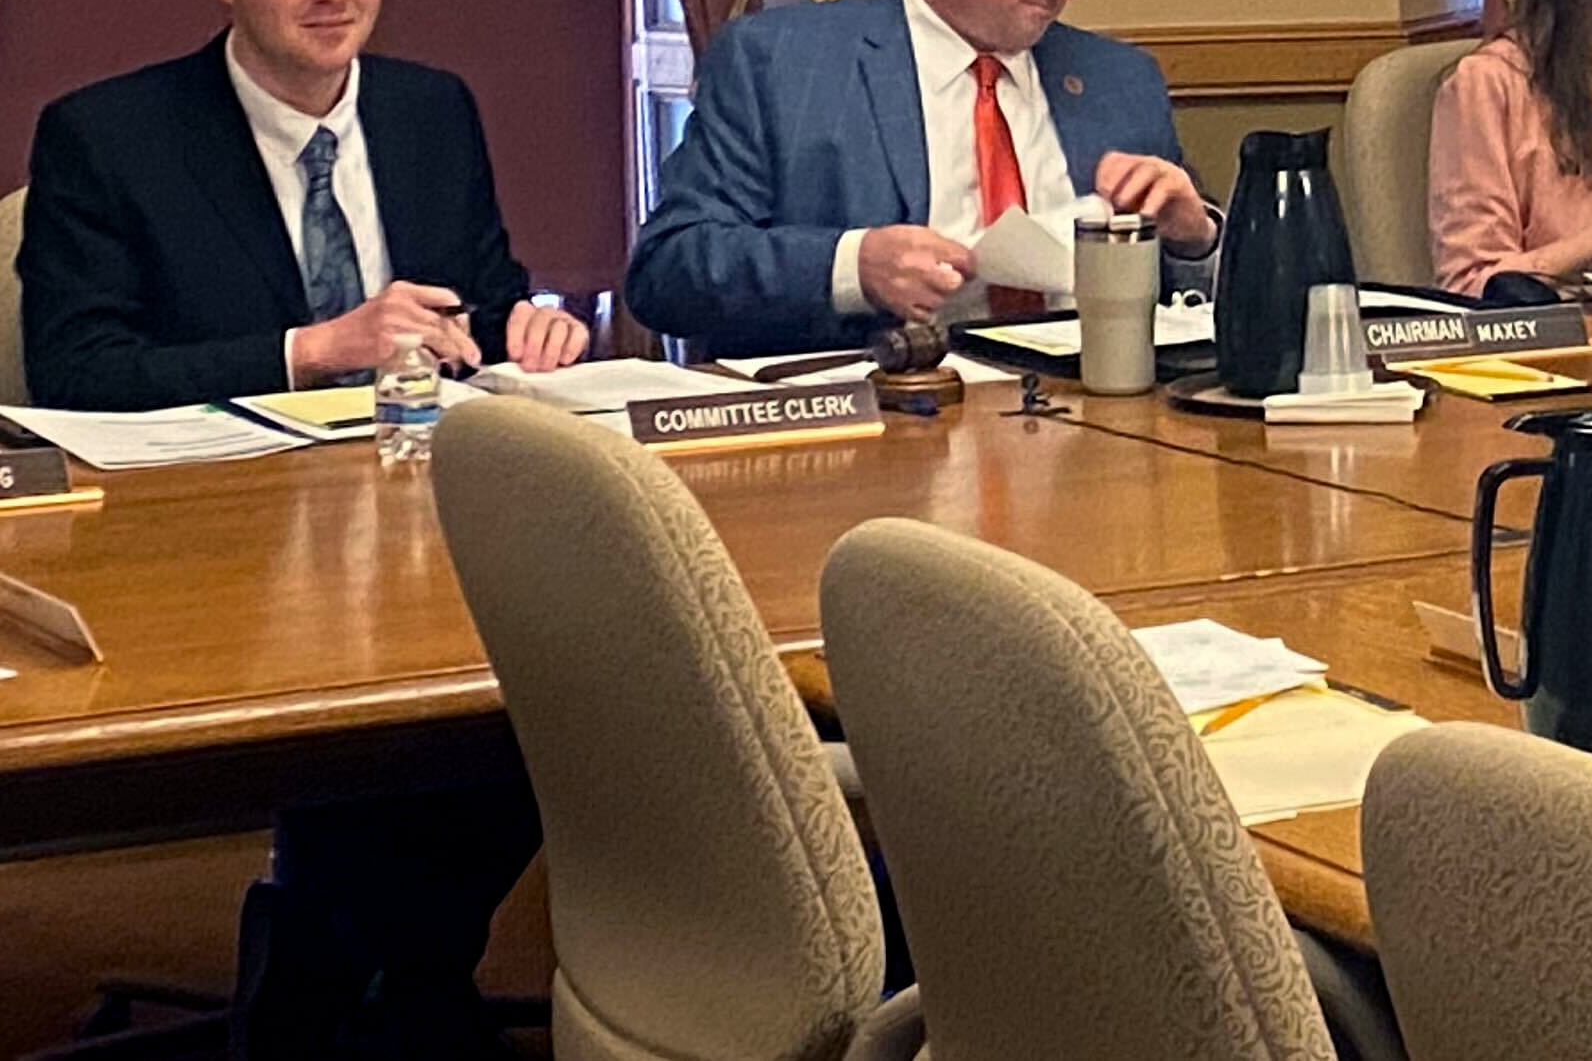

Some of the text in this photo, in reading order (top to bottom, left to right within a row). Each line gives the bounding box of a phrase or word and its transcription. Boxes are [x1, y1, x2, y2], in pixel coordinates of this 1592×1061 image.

[1366, 318, 1538, 347] CHAIRMAN MAXEY
[654, 393, 858, 434] COMMITTEE CLERK
